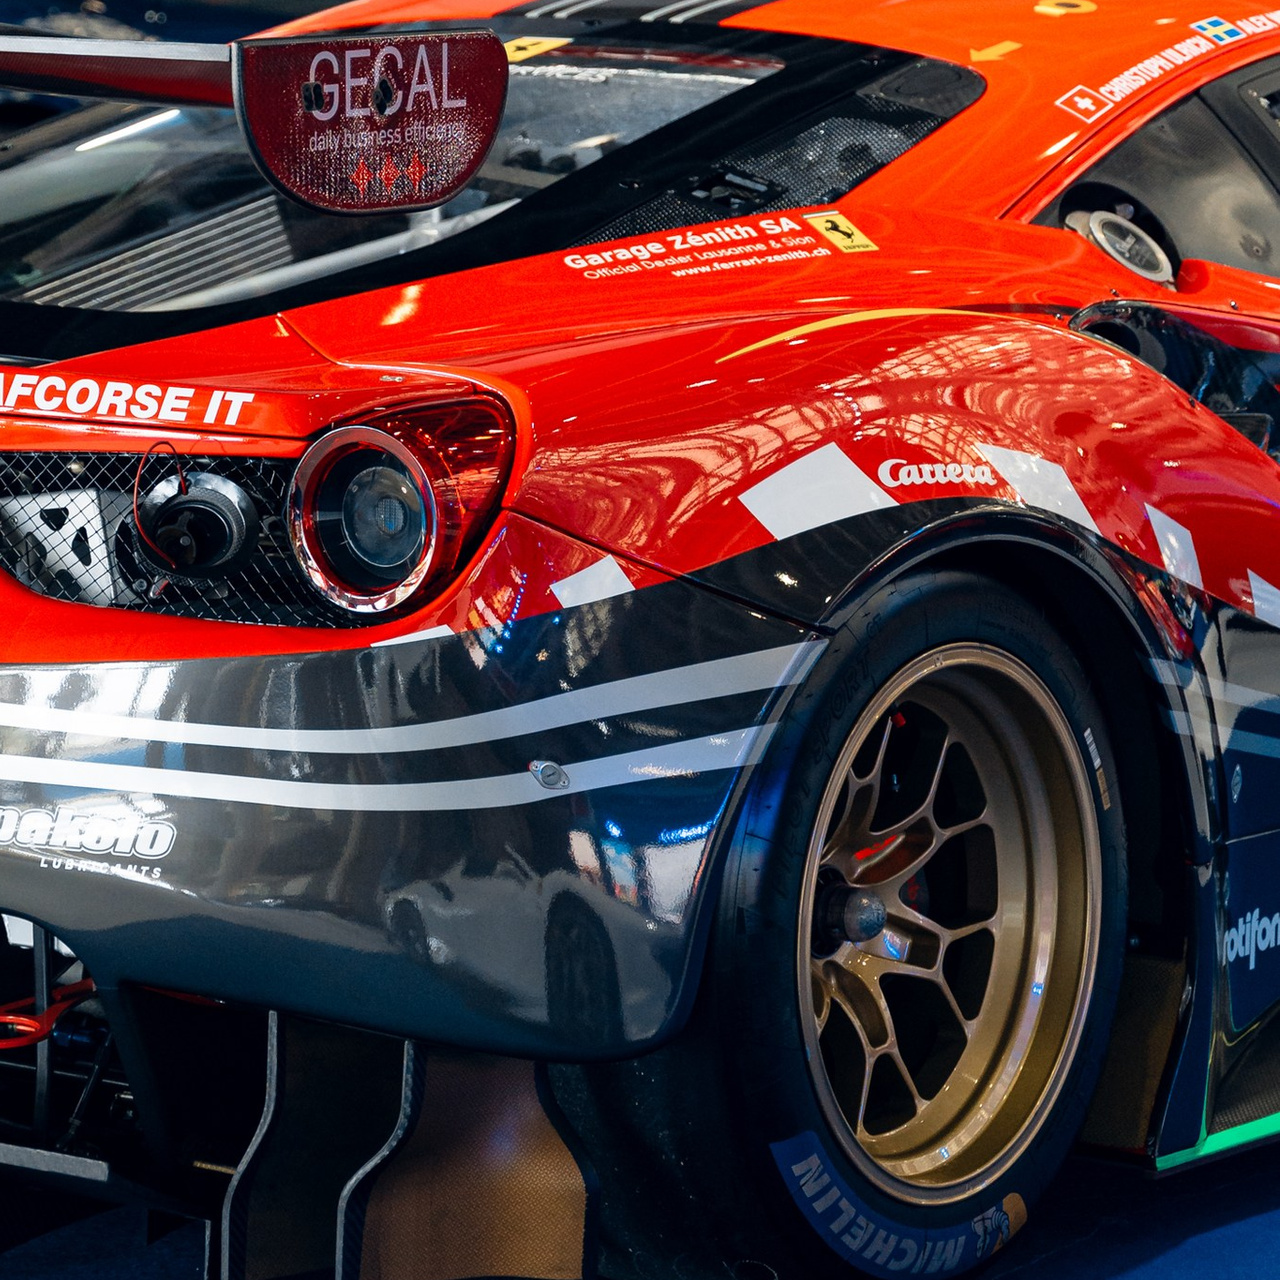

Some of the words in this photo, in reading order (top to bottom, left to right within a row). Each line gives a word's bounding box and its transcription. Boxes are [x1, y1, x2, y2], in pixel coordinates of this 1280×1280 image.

[309, 42, 467, 121] GECAL
[1098, 55, 1175, 102] CHRISTOPH
[1160, 35, 1215, 65] ULRICH
[309, 130, 340, 154] daily
[343, 127, 402, 149] business
[563, 239, 666, 270] Garage
[666, 222, 758, 250] Zénith
[759, 216, 802, 235] SA
[583, 259, 642, 280] Official
[644, 253, 692, 271] Dealer
[693, 243, 767, 263] Lausanne
[770, 238, 783, 251] &
[784, 234, 816, 247] Sion
[671, 246, 832, 278] www.ferrari-zenith.ch
[203, 390, 256, 426] IT
[878, 458, 998, 488] Carrera
[1222, 908, 1280, 970] rotifor
[791, 1153, 966, 1274] MICHELIN
